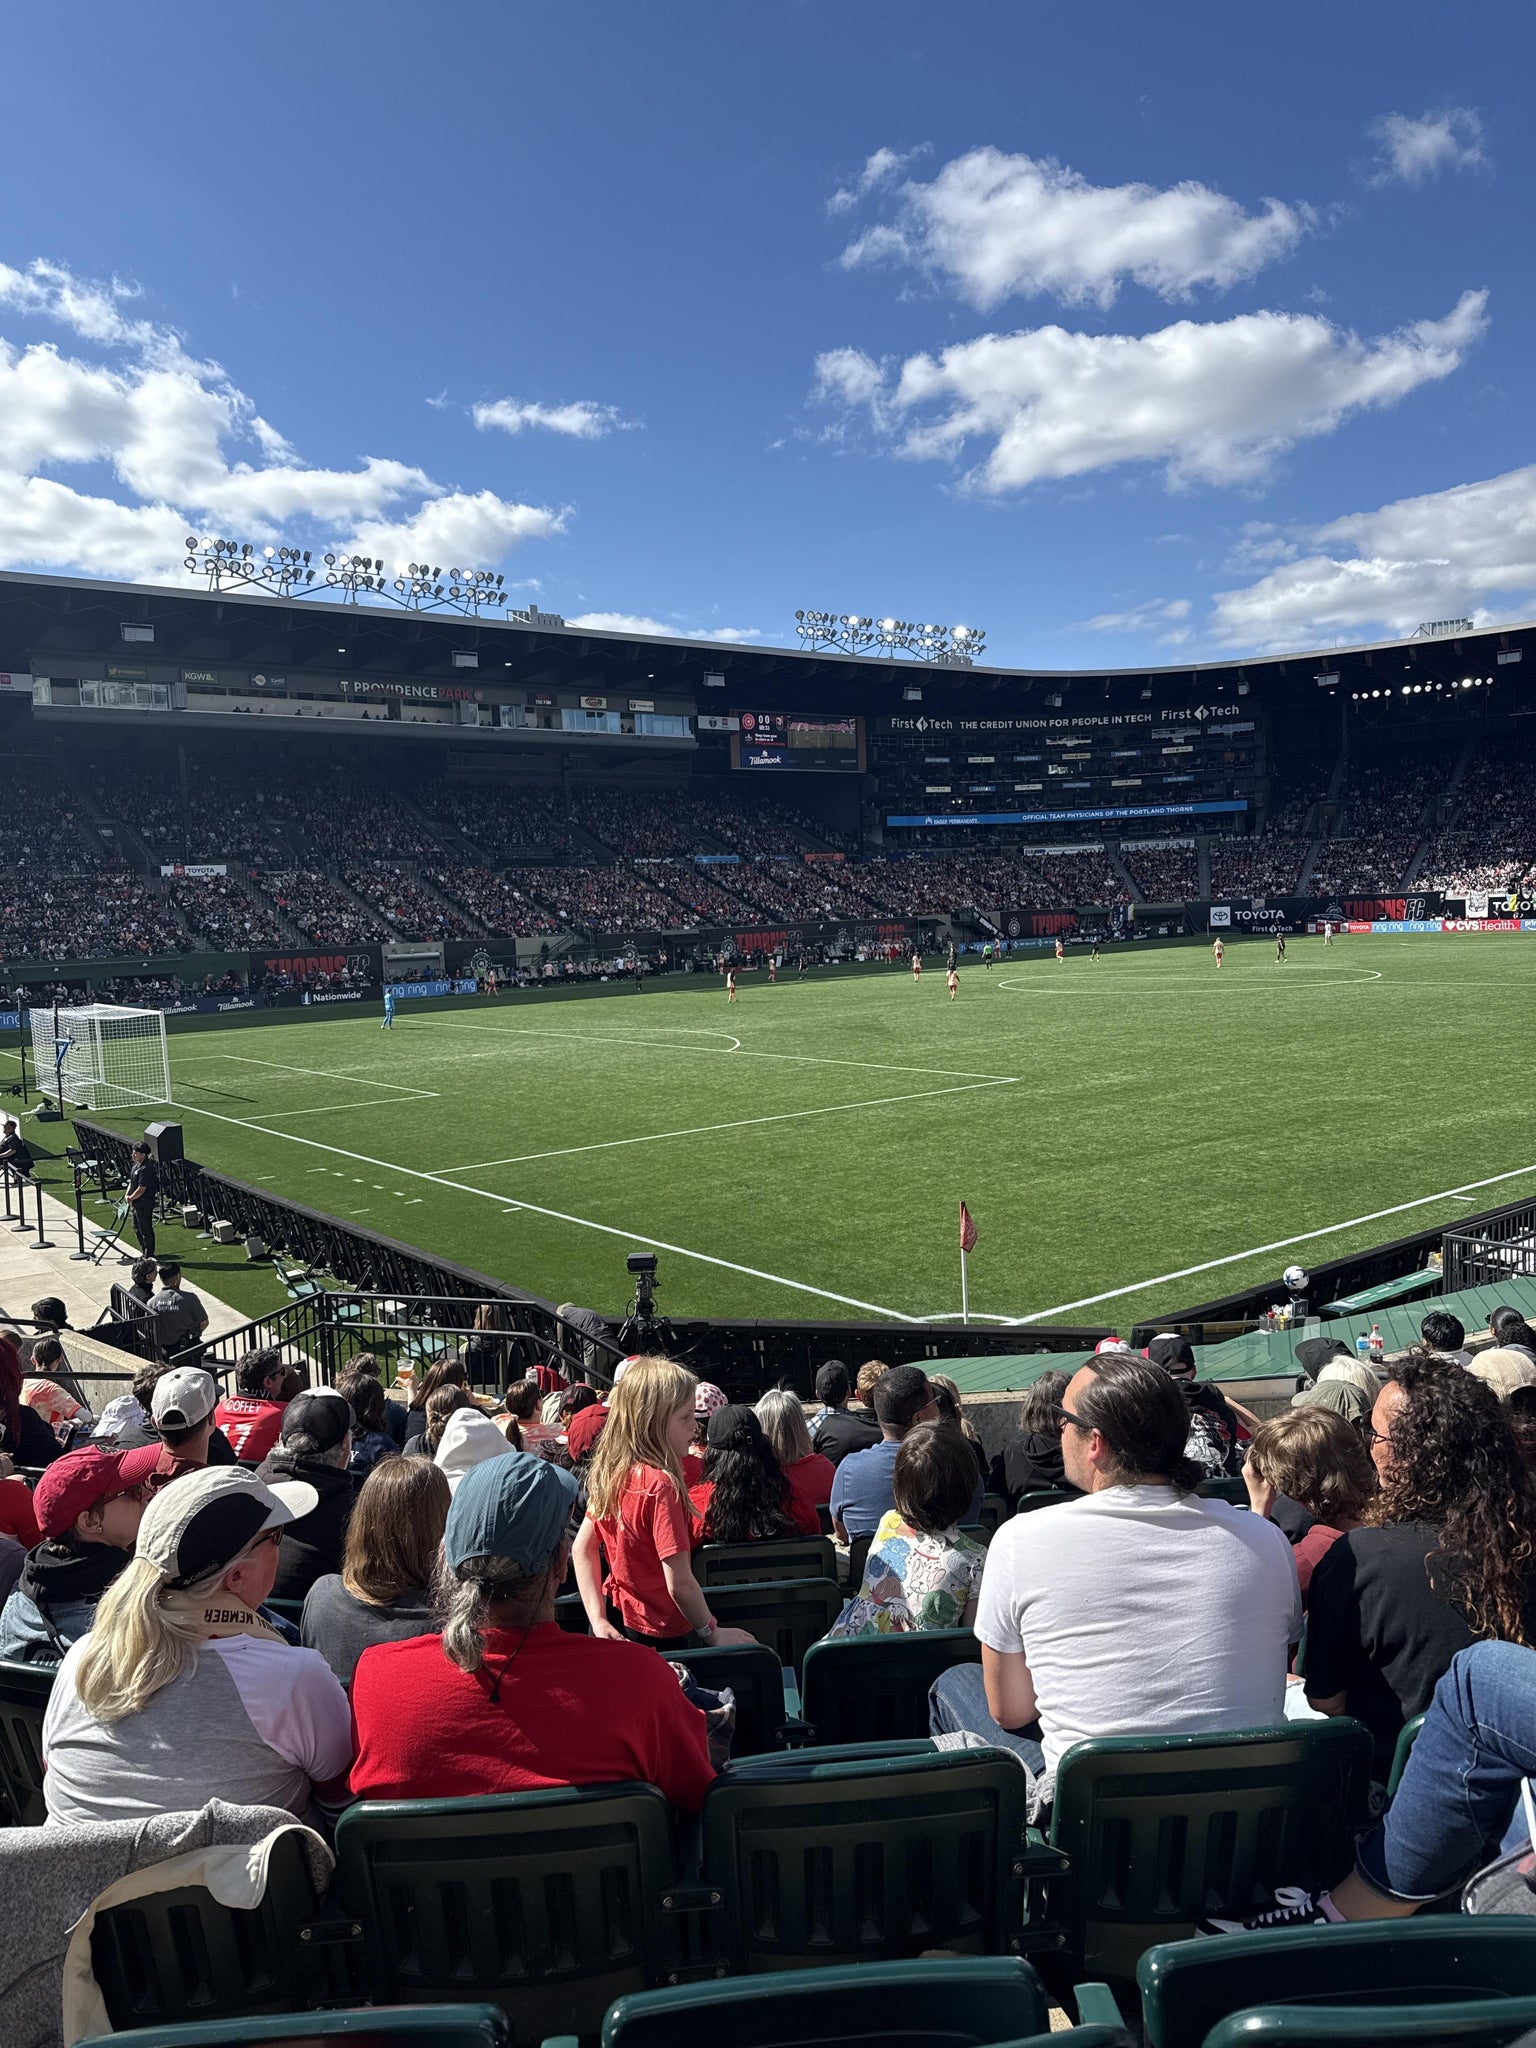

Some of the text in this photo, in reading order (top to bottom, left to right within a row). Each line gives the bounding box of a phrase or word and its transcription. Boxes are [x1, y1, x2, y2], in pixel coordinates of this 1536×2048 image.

[354, 682, 438, 698] PROVIDENCE
[1161, 704, 1240, 721] First Tech
[891, 718, 953, 730] First Tech
[960, 713, 1152, 730] THE CREDIT UNION FOR PEOPLE IN TECH
[749, 755, 782, 766] Tillamook
[1022, 813, 1048, 821] OFFICIAL
[1049, 812, 1066, 820] TEAM
[1067, 810, 1104, 819] PHYSICIANS
[1129, 807, 1165, 816] PORTLAND
[1234, 909, 1285, 921] TOYOTA
[1343, 897, 1426, 922] THORNS FC
[1031, 914, 1078, 936] THORNS
[1373, 923, 1387, 932] ring
[1389, 923, 1404, 932] ring
[1410, 923, 1424, 932] ring
[1427, 922, 1442, 932] ring
[312, 991, 362, 1002] Nationwide
[407, 985, 427, 996] ring
[160, 1003, 198, 1016] Tillamook
[217, 1000, 255, 1012] Tillamook
[226, 1399, 261, 1414] COFFEY
[204, 1608, 254, 1625] MEMBER
